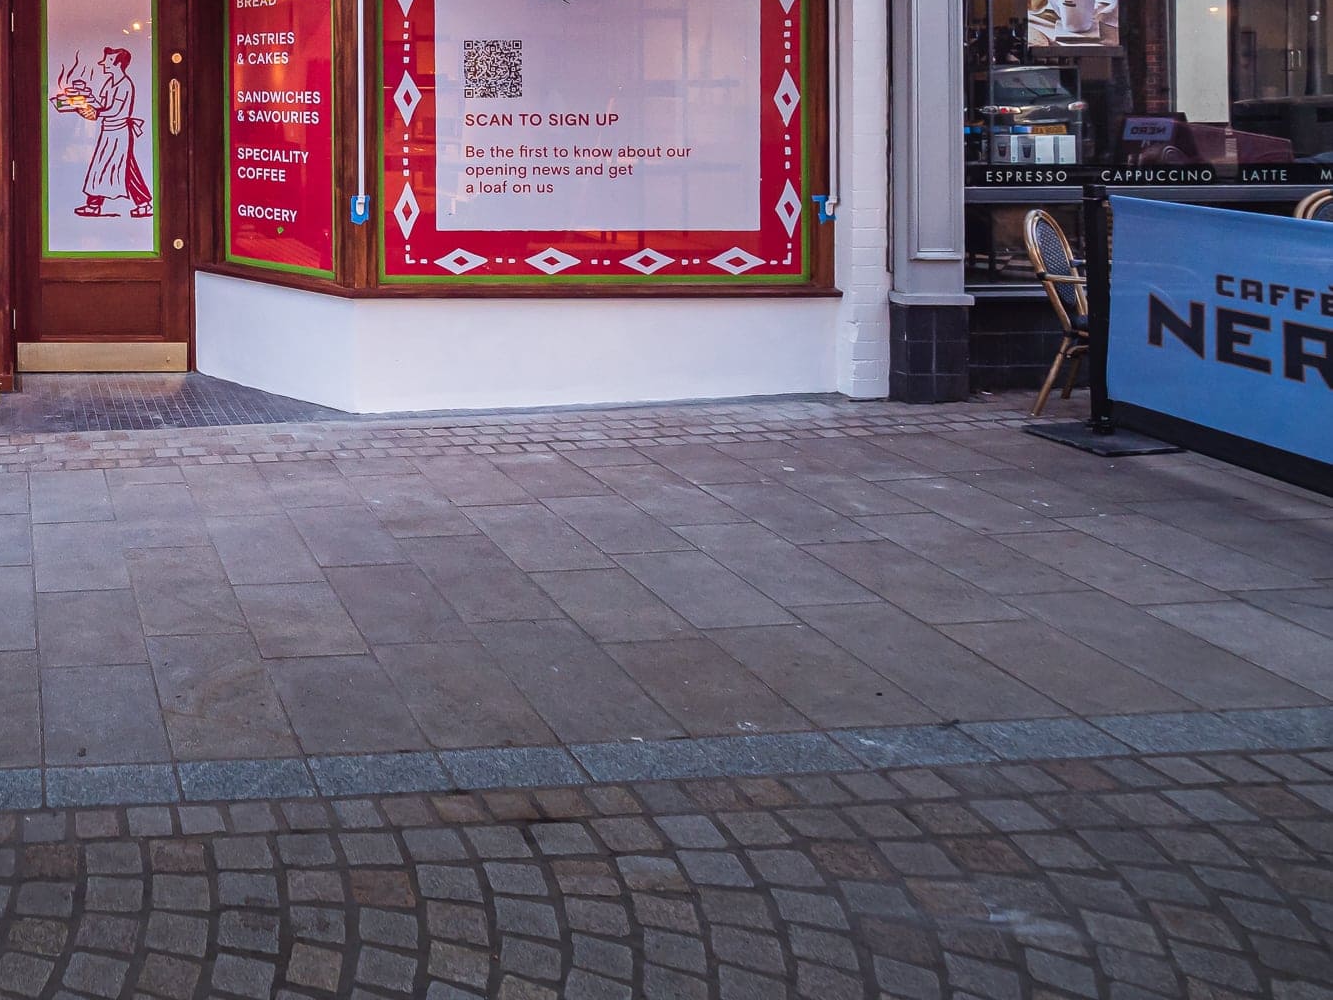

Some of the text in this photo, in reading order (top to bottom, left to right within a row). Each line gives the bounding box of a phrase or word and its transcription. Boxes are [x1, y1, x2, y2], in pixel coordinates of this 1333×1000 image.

[236, 32, 295, 46] PASTRIES
[237, 51, 289, 65] & CAKES
[237, 91, 321, 104] SANDWICHES
[237, 110, 320, 124] & SAVOURIES
[465, 113, 619, 127] SCAN TO SIGN UP
[237, 147, 309, 165] SPECIALITY
[465, 145, 691, 158] Be the first to know about our
[237, 166, 286, 182] COFFEE
[465, 163, 633, 179] opening news and get
[986, 171, 1067, 182] ESPRESSO
[1101, 170, 1212, 181] CAPPUCCINO
[1242, 170, 1287, 181] LATTE
[465, 180, 554, 193] a loaf on us
[237, 204, 297, 223] GROCERY
